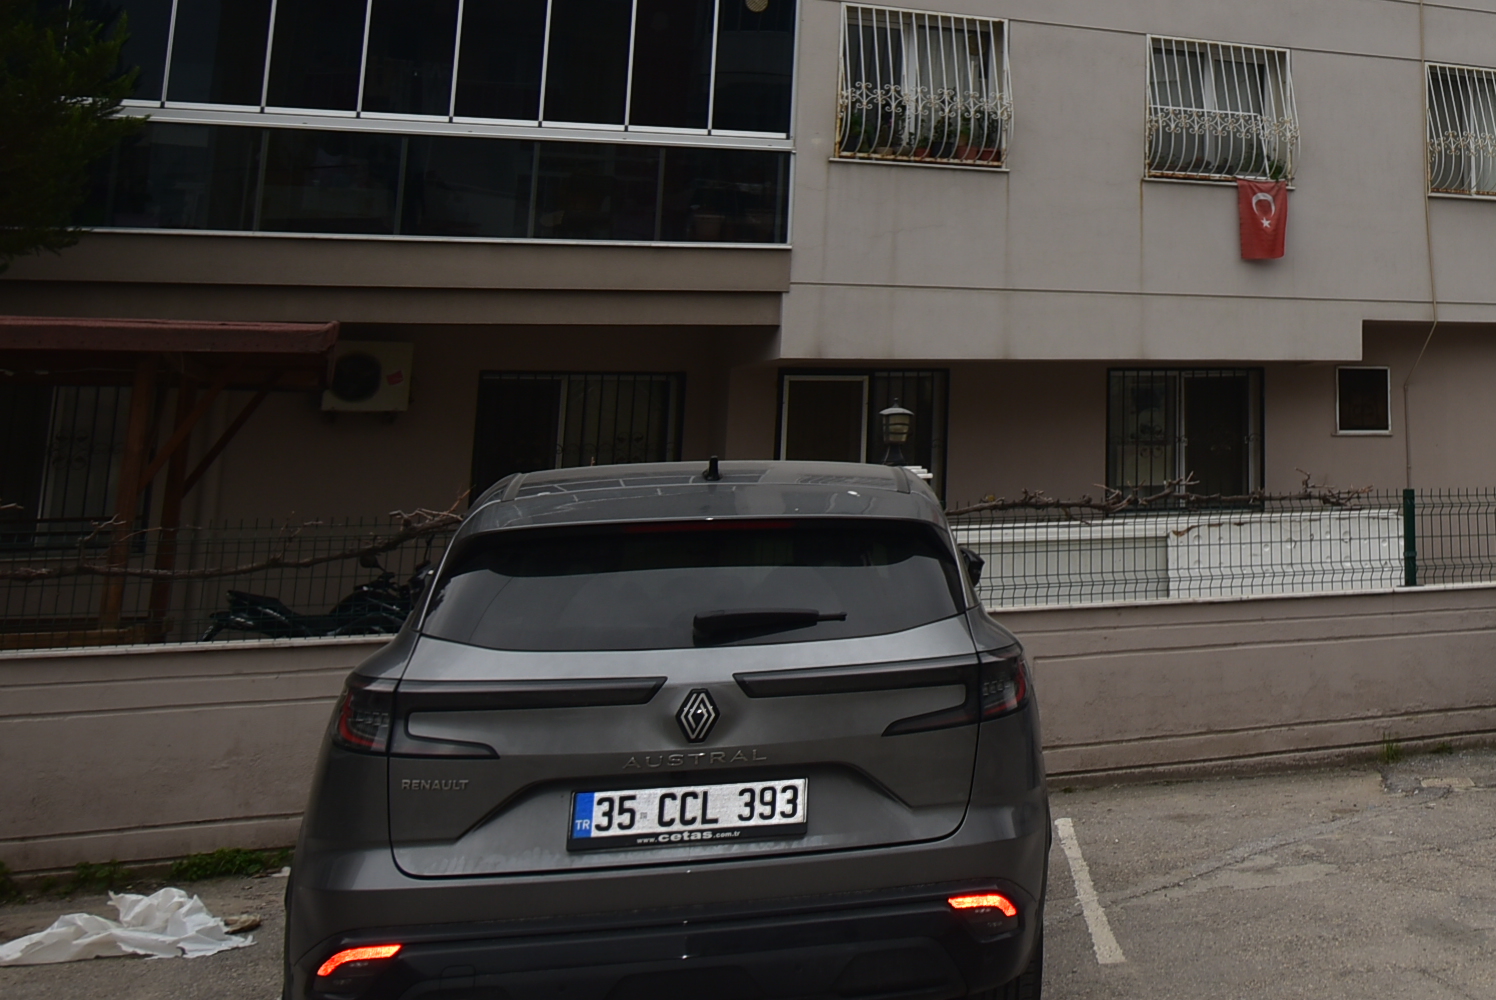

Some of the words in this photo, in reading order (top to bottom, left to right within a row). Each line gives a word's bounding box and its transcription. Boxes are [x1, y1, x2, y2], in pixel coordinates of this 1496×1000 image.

[621, 749, 768, 770] AUSTRAL
[401, 778, 470, 791] RENAULT
[575, 818, 591, 831] TR
[594, 795, 637, 832] 35
[657, 790, 719, 828] CCL
[737, 784, 799, 822] 393
[636, 829, 741, 844] www.cetas.com.tr
